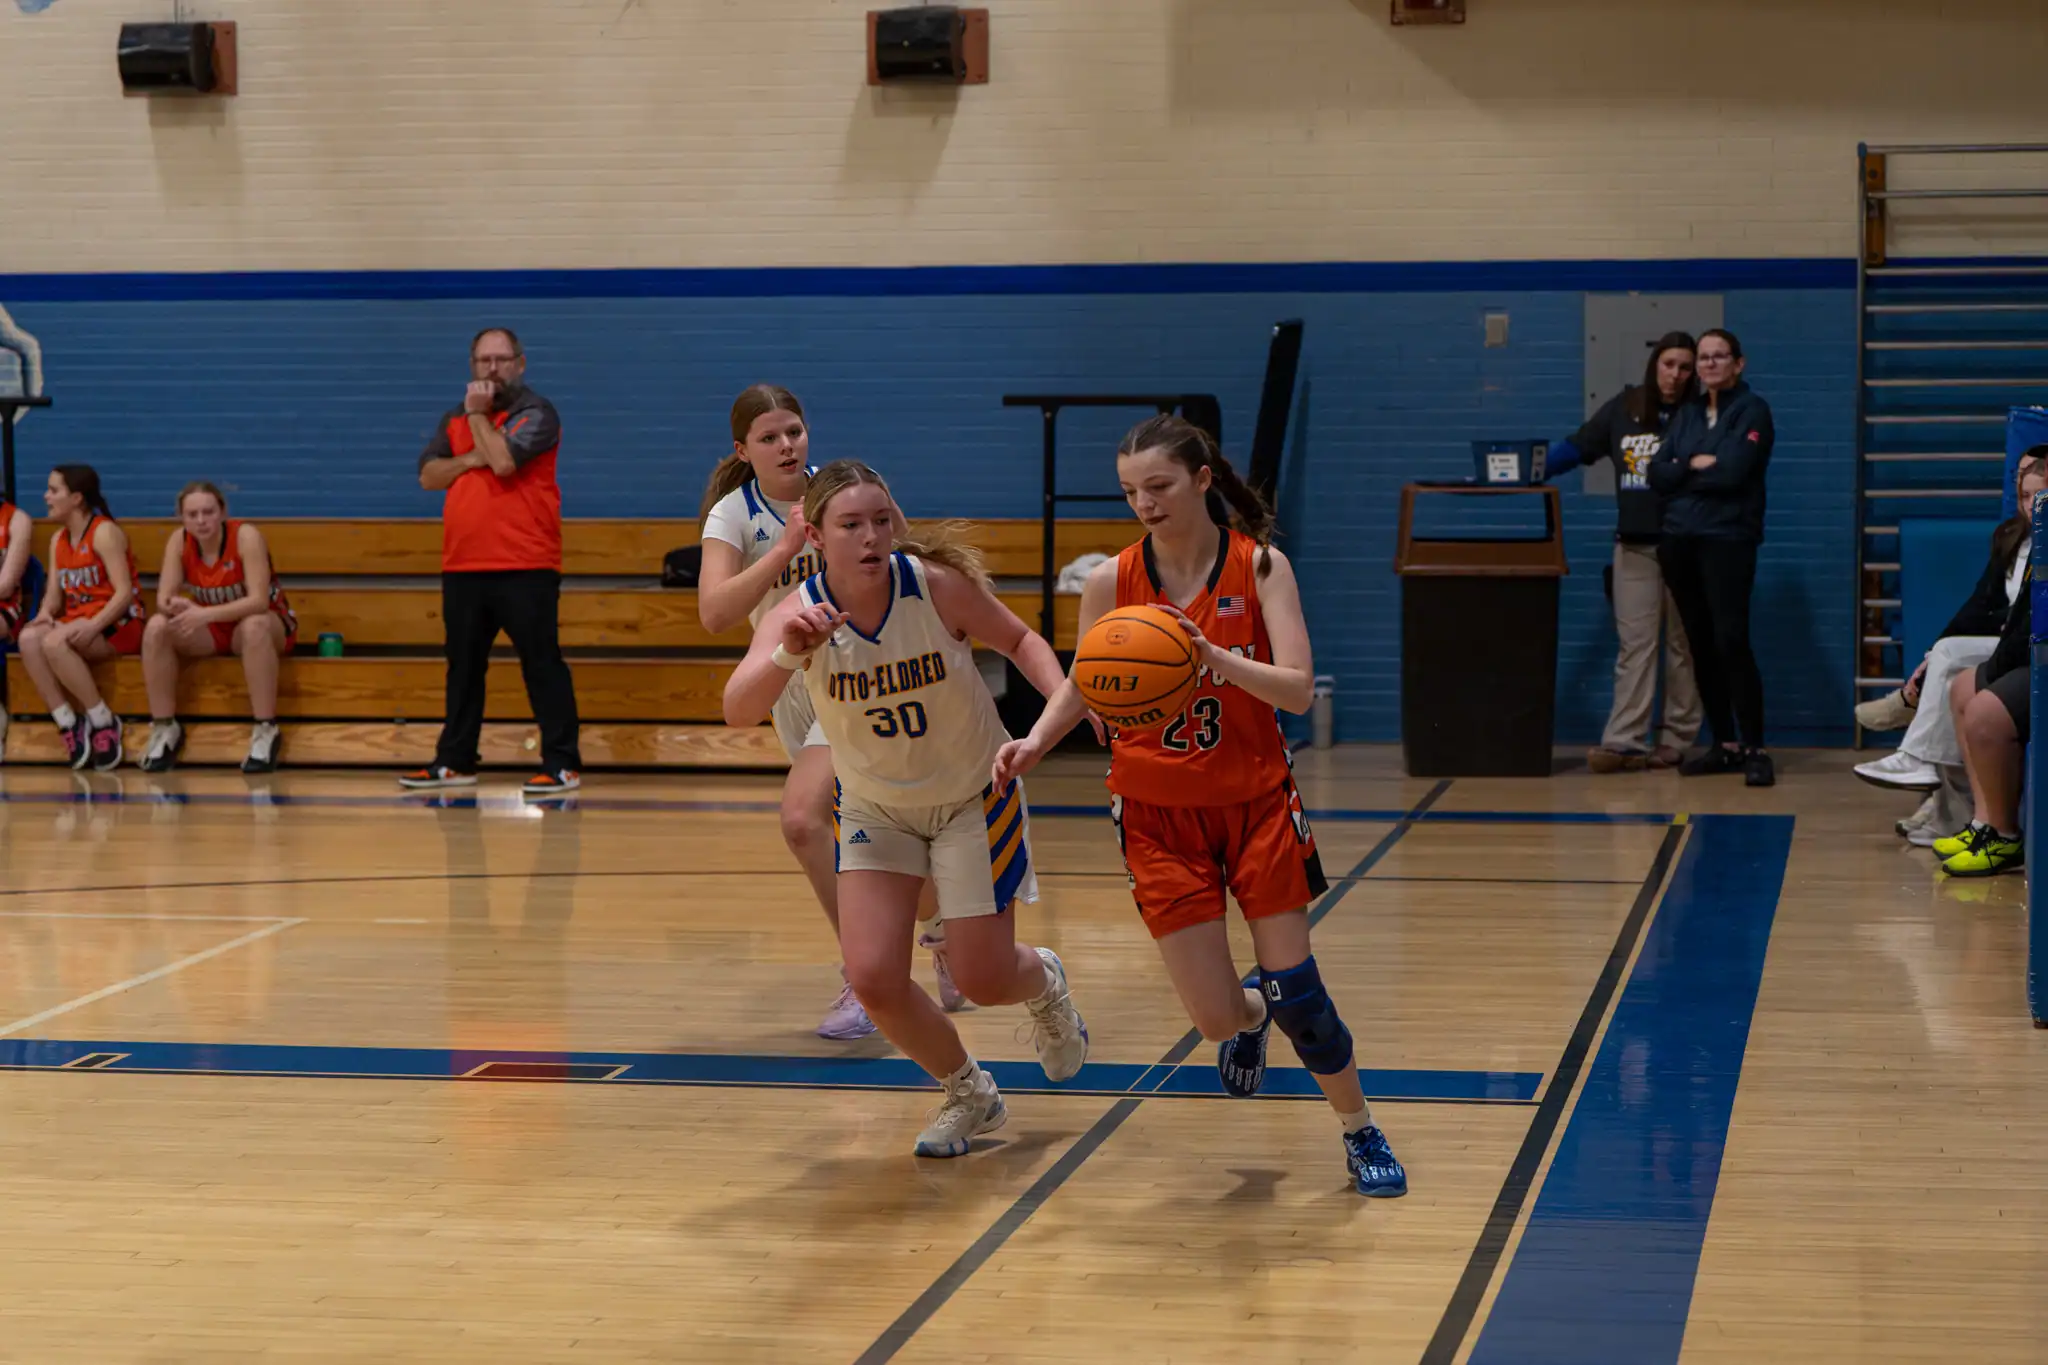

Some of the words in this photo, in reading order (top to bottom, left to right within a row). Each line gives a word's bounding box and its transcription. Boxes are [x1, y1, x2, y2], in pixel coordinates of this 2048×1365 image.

[828, 650, 947, 702] OTTO-ELDRED
[863, 701, 928, 739] 30
[1161, 695, 1222, 752] 23
